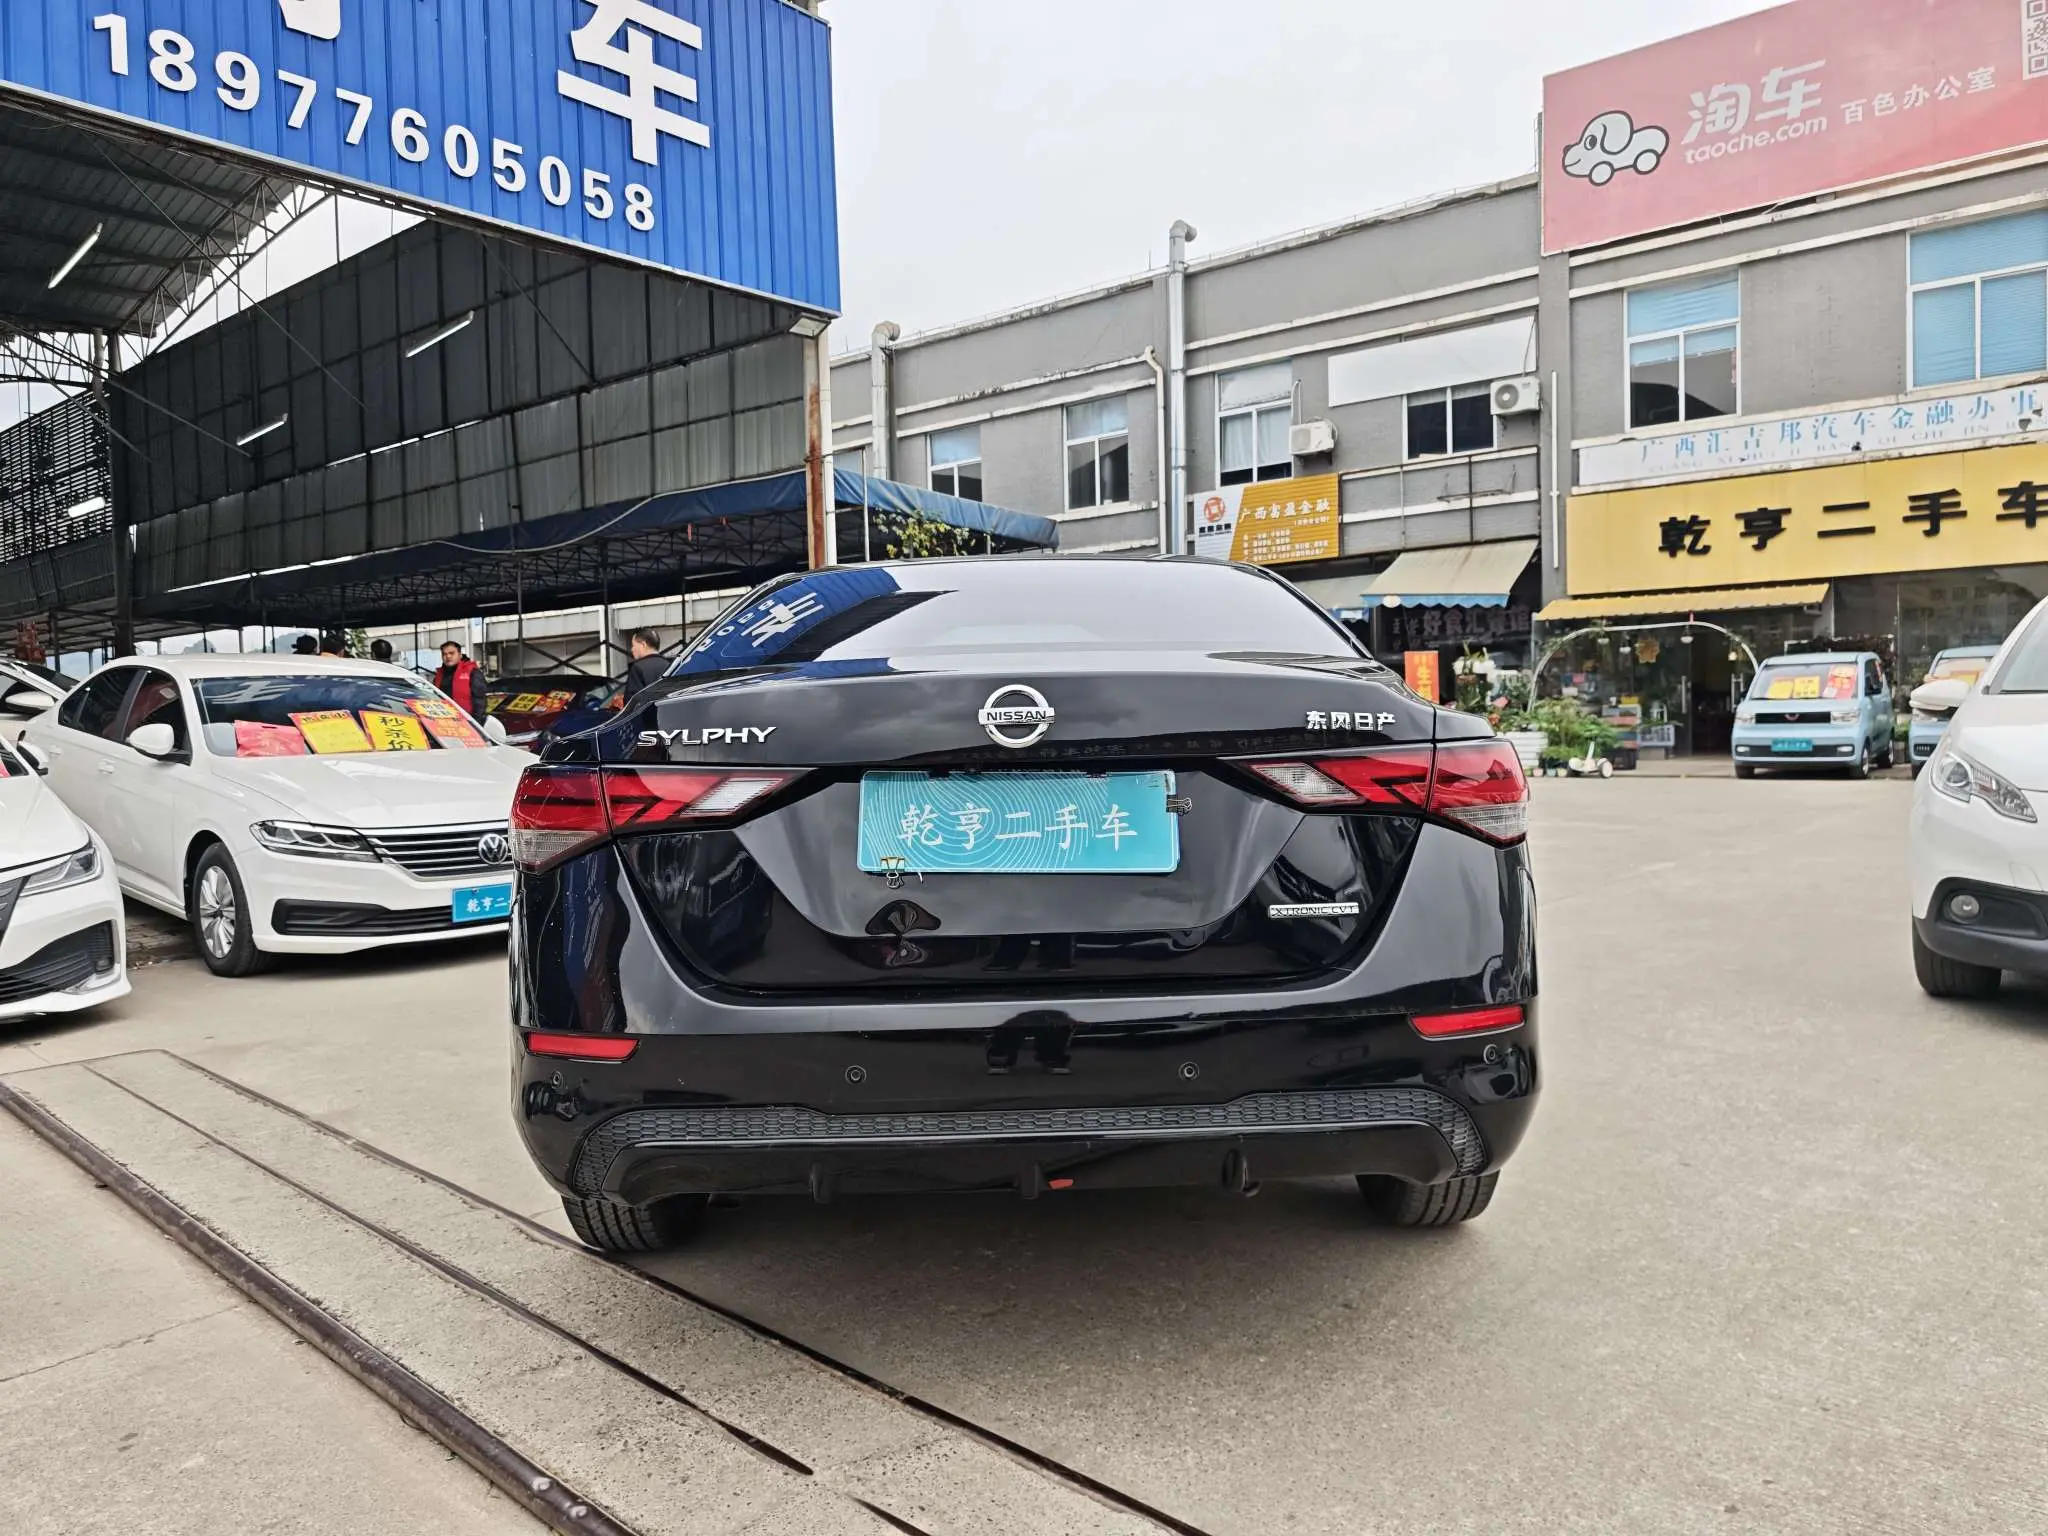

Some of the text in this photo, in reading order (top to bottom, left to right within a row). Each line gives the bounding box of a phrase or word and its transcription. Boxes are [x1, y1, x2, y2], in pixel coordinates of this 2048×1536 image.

[93, 13, 656, 232] 18977605058
[1681, 59, 1997, 145] 淘车 百色办公室
[1684, 115, 1828, 165] taoche.com
[1657, 480, 2048, 558] 乾亨二手车
[637, 726, 776, 747] SYLPHY
[986, 710, 1046, 721] NISSAN
[1305, 710, 1396, 731] 东风日产
[898, 803, 1138, 850] 乾亨二手车
[466, 896, 508, 913] 乾亨二
